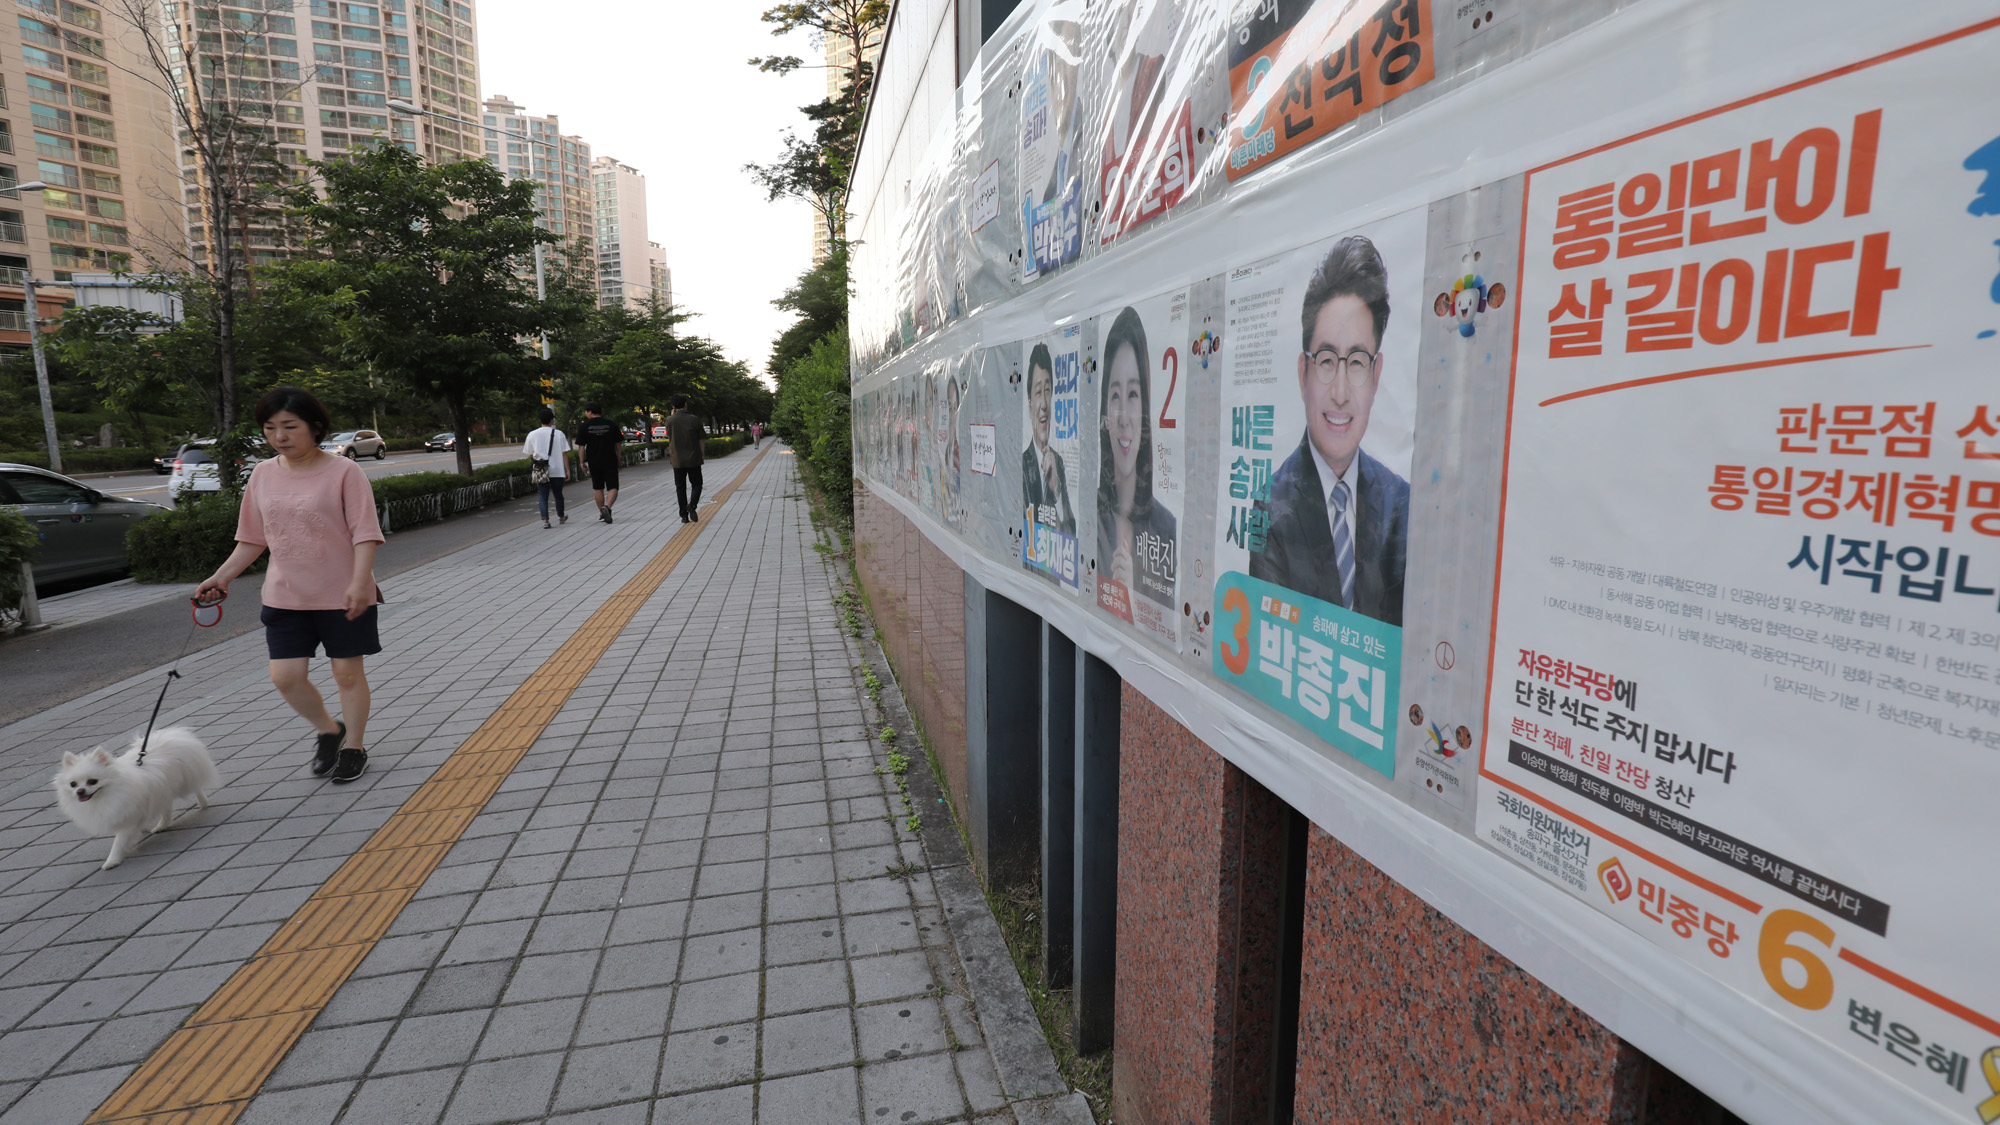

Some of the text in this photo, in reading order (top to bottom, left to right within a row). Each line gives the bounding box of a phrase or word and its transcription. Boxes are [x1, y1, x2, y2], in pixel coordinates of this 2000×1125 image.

[1024, 106, 1047, 150] 송파!
[1230, 127, 1276, 170] 바른미래당
[1552, 108, 1883, 270] 통일만이
[1548, 231, 1901, 358] 살 길이다
[1054, 351, 1079, 394] 했다
[1159, 346, 1178, 428] 2
[1055, 398, 1078, 440] 한다
[1232, 405, 1274, 451] 바른
[1777, 402, 1936, 458] 판문점
[1229, 456, 1274, 503] 송파
[1027, 503, 1036, 562] 1
[1037, 527, 1075, 580] 최재성
[1135, 531, 1175, 582] 배현진
[1226, 505, 1271, 553] 사람
[1220, 587, 1250, 675] 3
[1549, 555, 1565, 568] 석유
[1606, 566, 1624, 580] 공동
[1626, 570, 1647, 585] 개발
[1730, 587, 1780, 610] 인공위성
[1783, 597, 1797, 613] 및
[1798, 600, 1856, 625] 우주개발
[1859, 610, 1891, 630] 협력
[1907, 620, 1926, 638] 제
[1946, 627, 1966, 645] 제
[1313, 615, 1386, 659] 송파에 살고 있는
[1606, 587, 1633, 605] 동서해
[1634, 594, 1655, 610] 공동
[1657, 599, 1680, 615] 어업
[1681, 602, 1703, 619] 협력
[1715, 610, 1764, 633] 남북농업
[1765, 620, 1819, 645] 협력으로
[1821, 632, 1881, 659] 식량주권
[1884, 645, 1916, 665] 확보
[1935, 656, 1989, 682] 한반도
[1623, 615, 1643, 632] 통일
[1644, 620, 1666, 636] 도시
[1678, 628, 1701, 644] 남북
[1842, 665, 1873, 686] 평화
[1259, 619, 1386, 750] 박종진
[1518, 648, 1637, 712] 자유한국당에
[1773, 675, 1827, 702] 일자리는
[1511, 716, 1695, 809] 분단 적폐, 친일 잔당 청산
[1515, 679, 1737, 785] 단 한 석도 주지 맙시다
[1497, 790, 1590, 857] 국회의원재선거
[1521, 751, 1861, 916] 이승만 박정희 전두환 이명박 박근혜의 부끄러운 역사를 끝냅시다
[1527, 828, 1552, 848] 송파구
[1636, 877, 1740, 959] 민중당
[1758, 909, 1836, 1011] 6
[1846, 999, 1969, 1094] 변은혜
